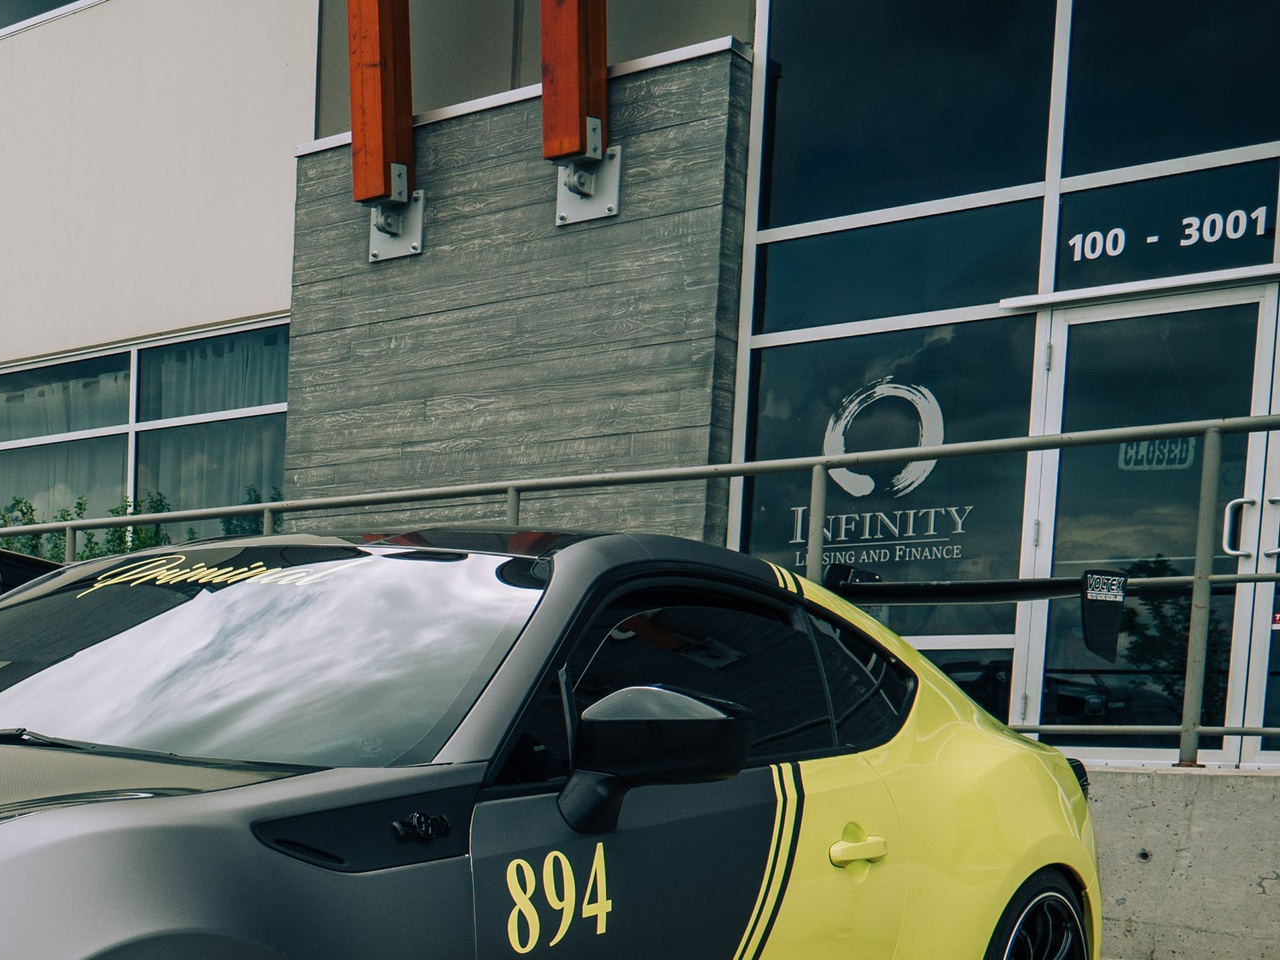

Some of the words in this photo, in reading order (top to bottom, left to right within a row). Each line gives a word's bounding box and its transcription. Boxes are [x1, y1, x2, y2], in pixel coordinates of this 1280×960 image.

[1068, 227, 1126, 262] 100
[1180, 206, 1267, 246] 3001
[1123, 437, 1191, 466] CLOSED
[795, 551, 856, 567] LSING
[859, 549, 890, 563] AND
[895, 545, 962, 561] FINANCE
[1087, 574, 1125, 593] VOLTEX
[506, 841, 613, 954] 894
